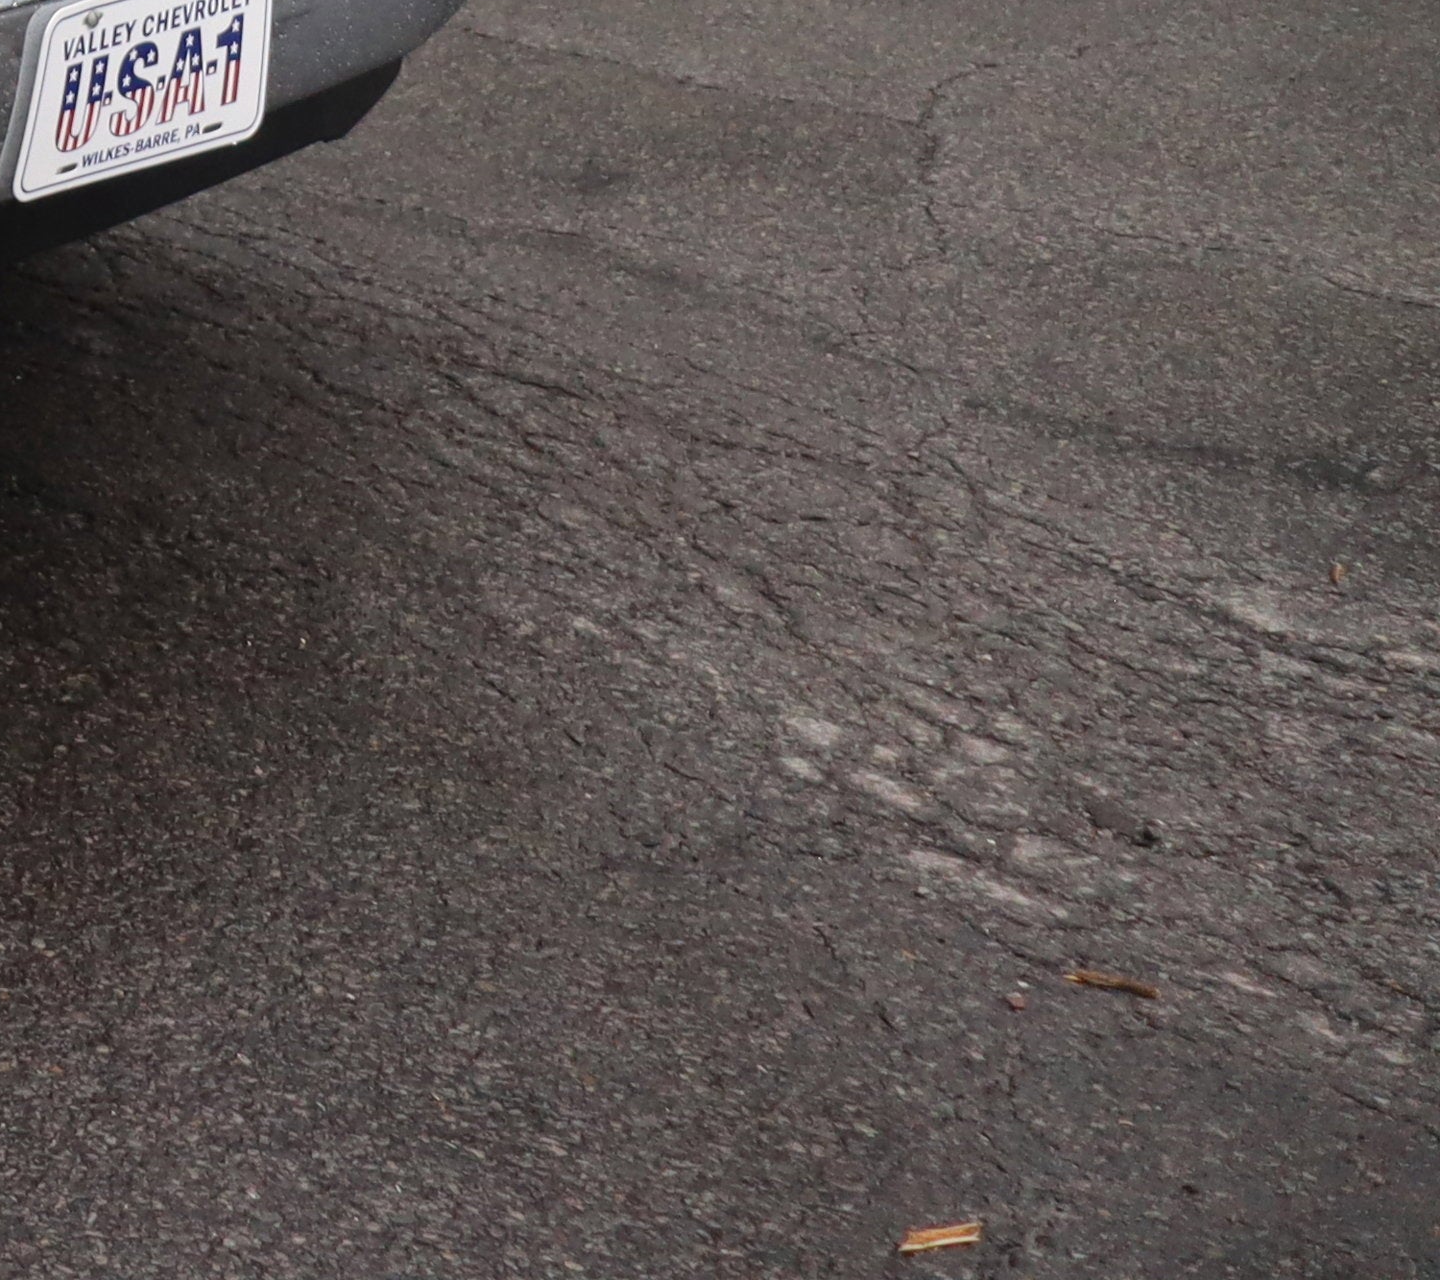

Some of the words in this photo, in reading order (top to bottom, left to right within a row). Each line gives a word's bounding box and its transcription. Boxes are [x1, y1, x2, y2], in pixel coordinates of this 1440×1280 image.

[64, 20, 136, 61] VALLEY
[82, 129, 180, 167] WILKES-BARRE,
[185, 123, 201, 140] PA
